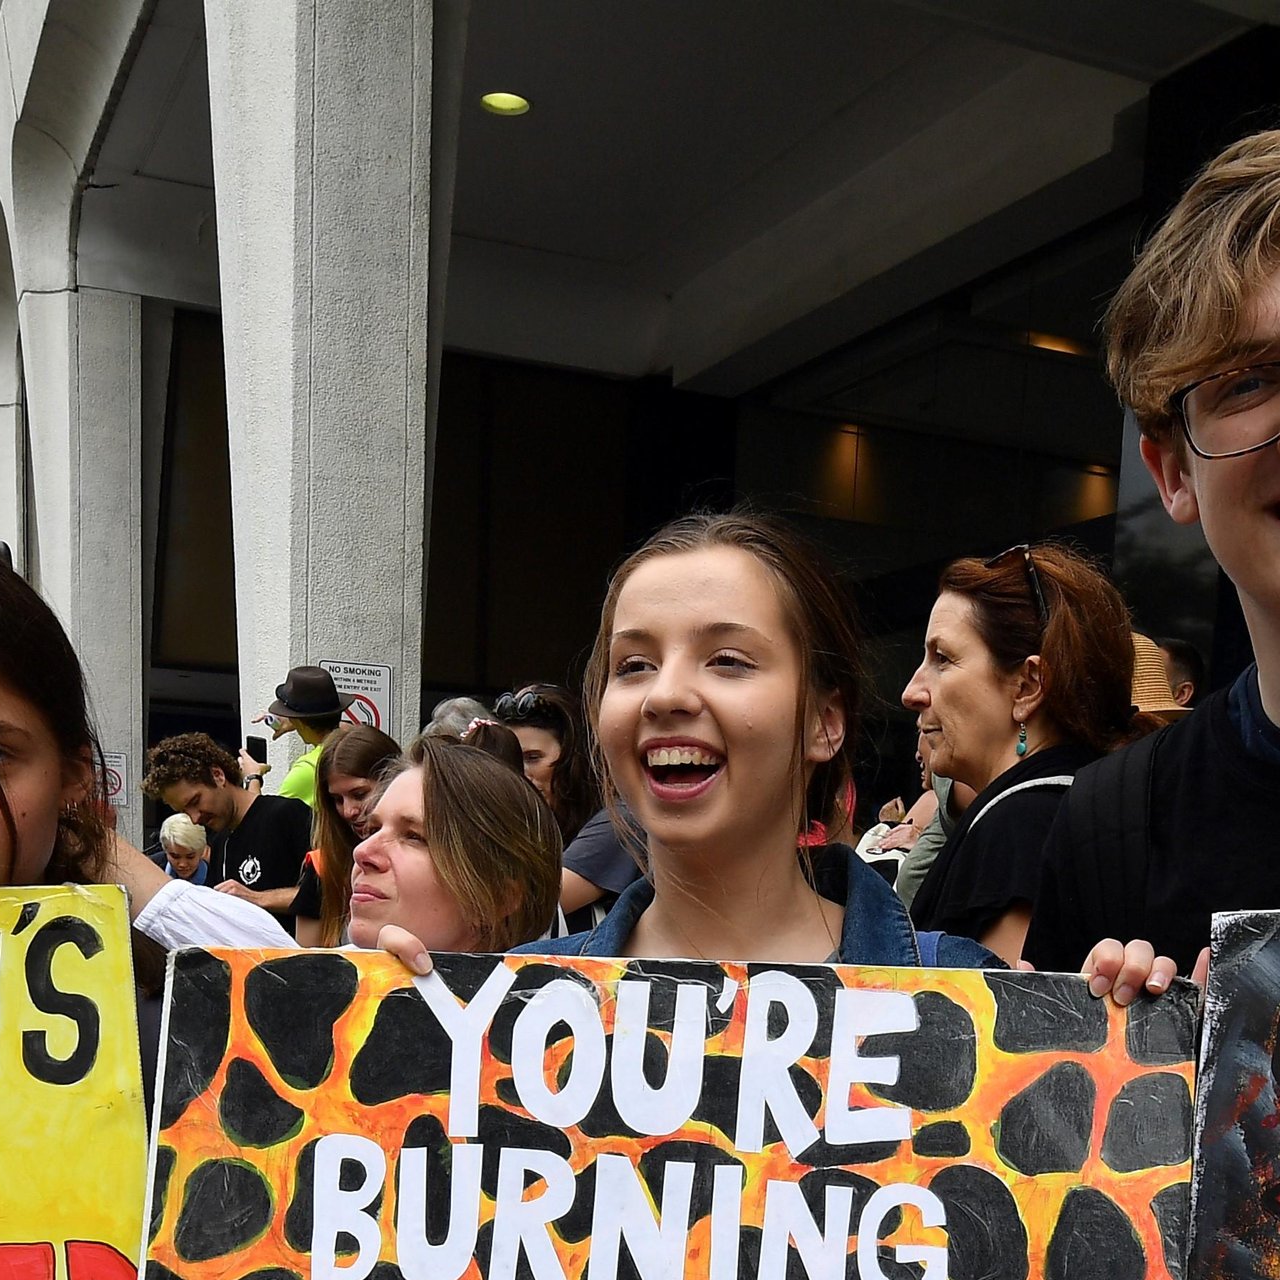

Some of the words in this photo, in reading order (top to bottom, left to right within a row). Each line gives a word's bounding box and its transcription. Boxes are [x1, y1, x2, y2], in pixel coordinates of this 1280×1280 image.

[329, 665, 341, 673] NO
[344, 667, 381, 677] SMOKING
[411, 962, 919, 1158] YOU'RE
